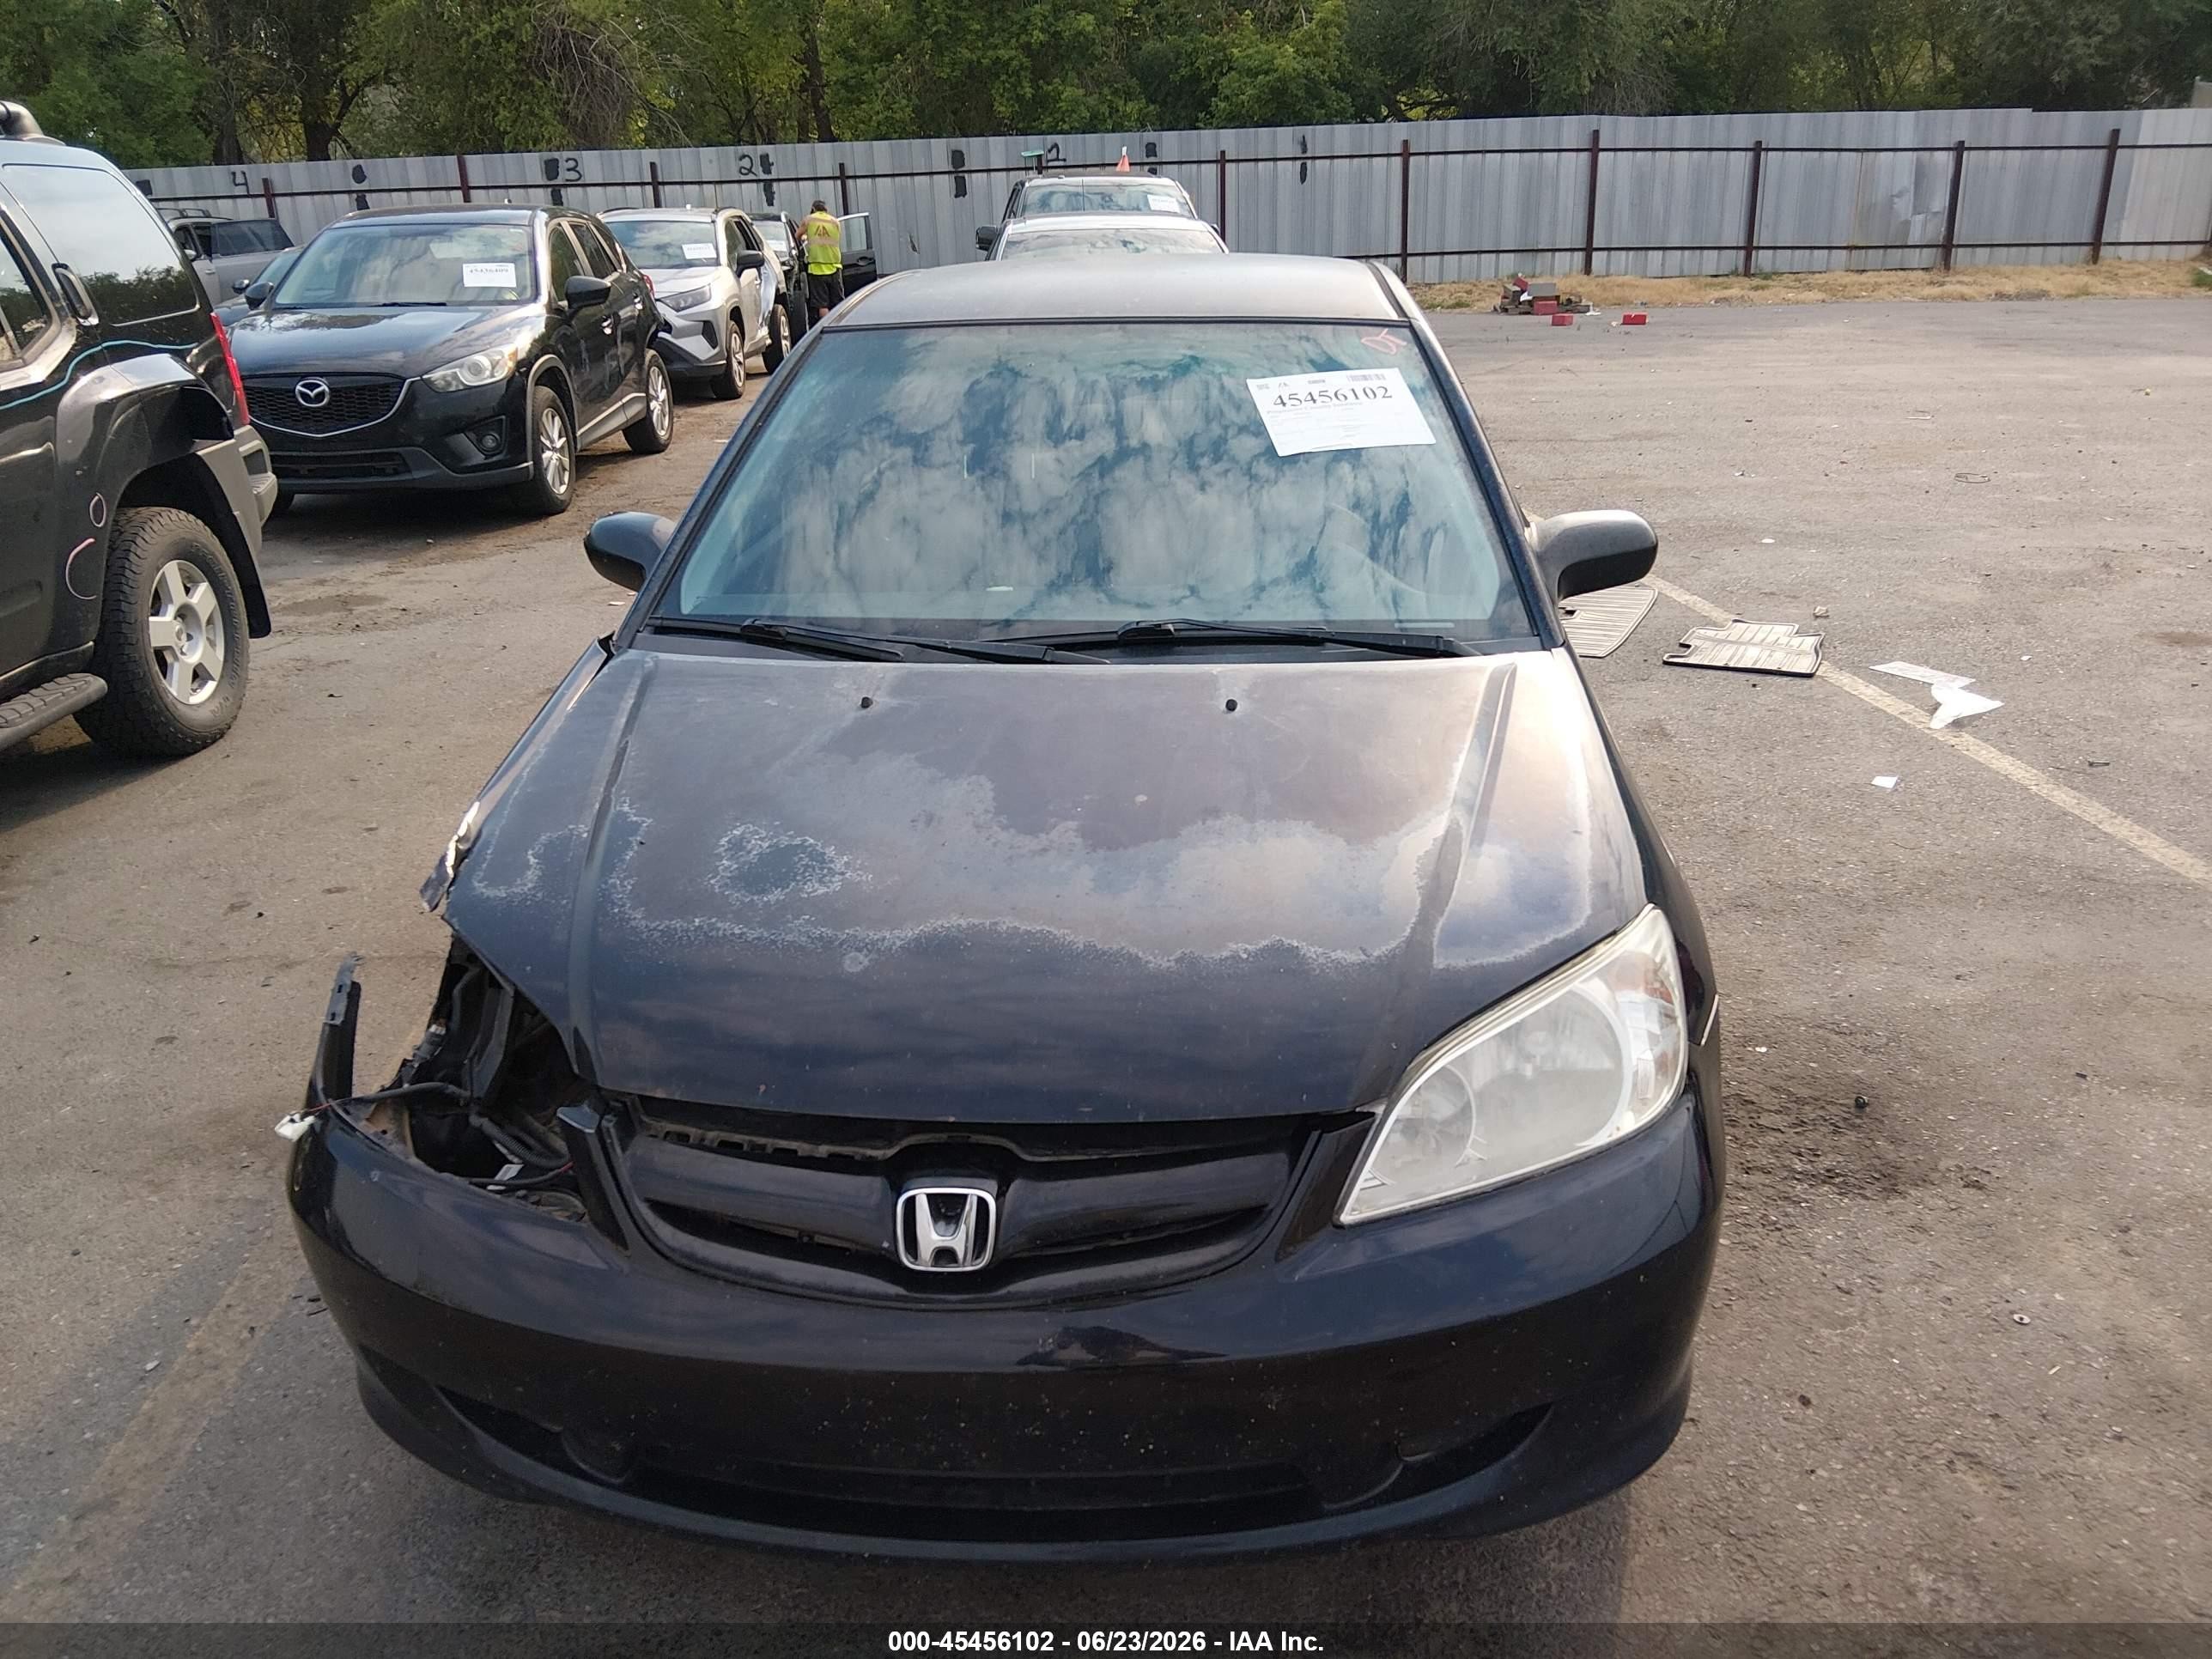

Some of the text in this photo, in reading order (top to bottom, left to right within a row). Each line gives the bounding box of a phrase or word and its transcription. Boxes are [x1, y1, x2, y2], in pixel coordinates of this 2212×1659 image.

[565, 157, 583, 182] 3
[738, 154, 758, 177] 2
[230, 170, 250, 197] 4
[1273, 386, 1394, 408] 45456102
